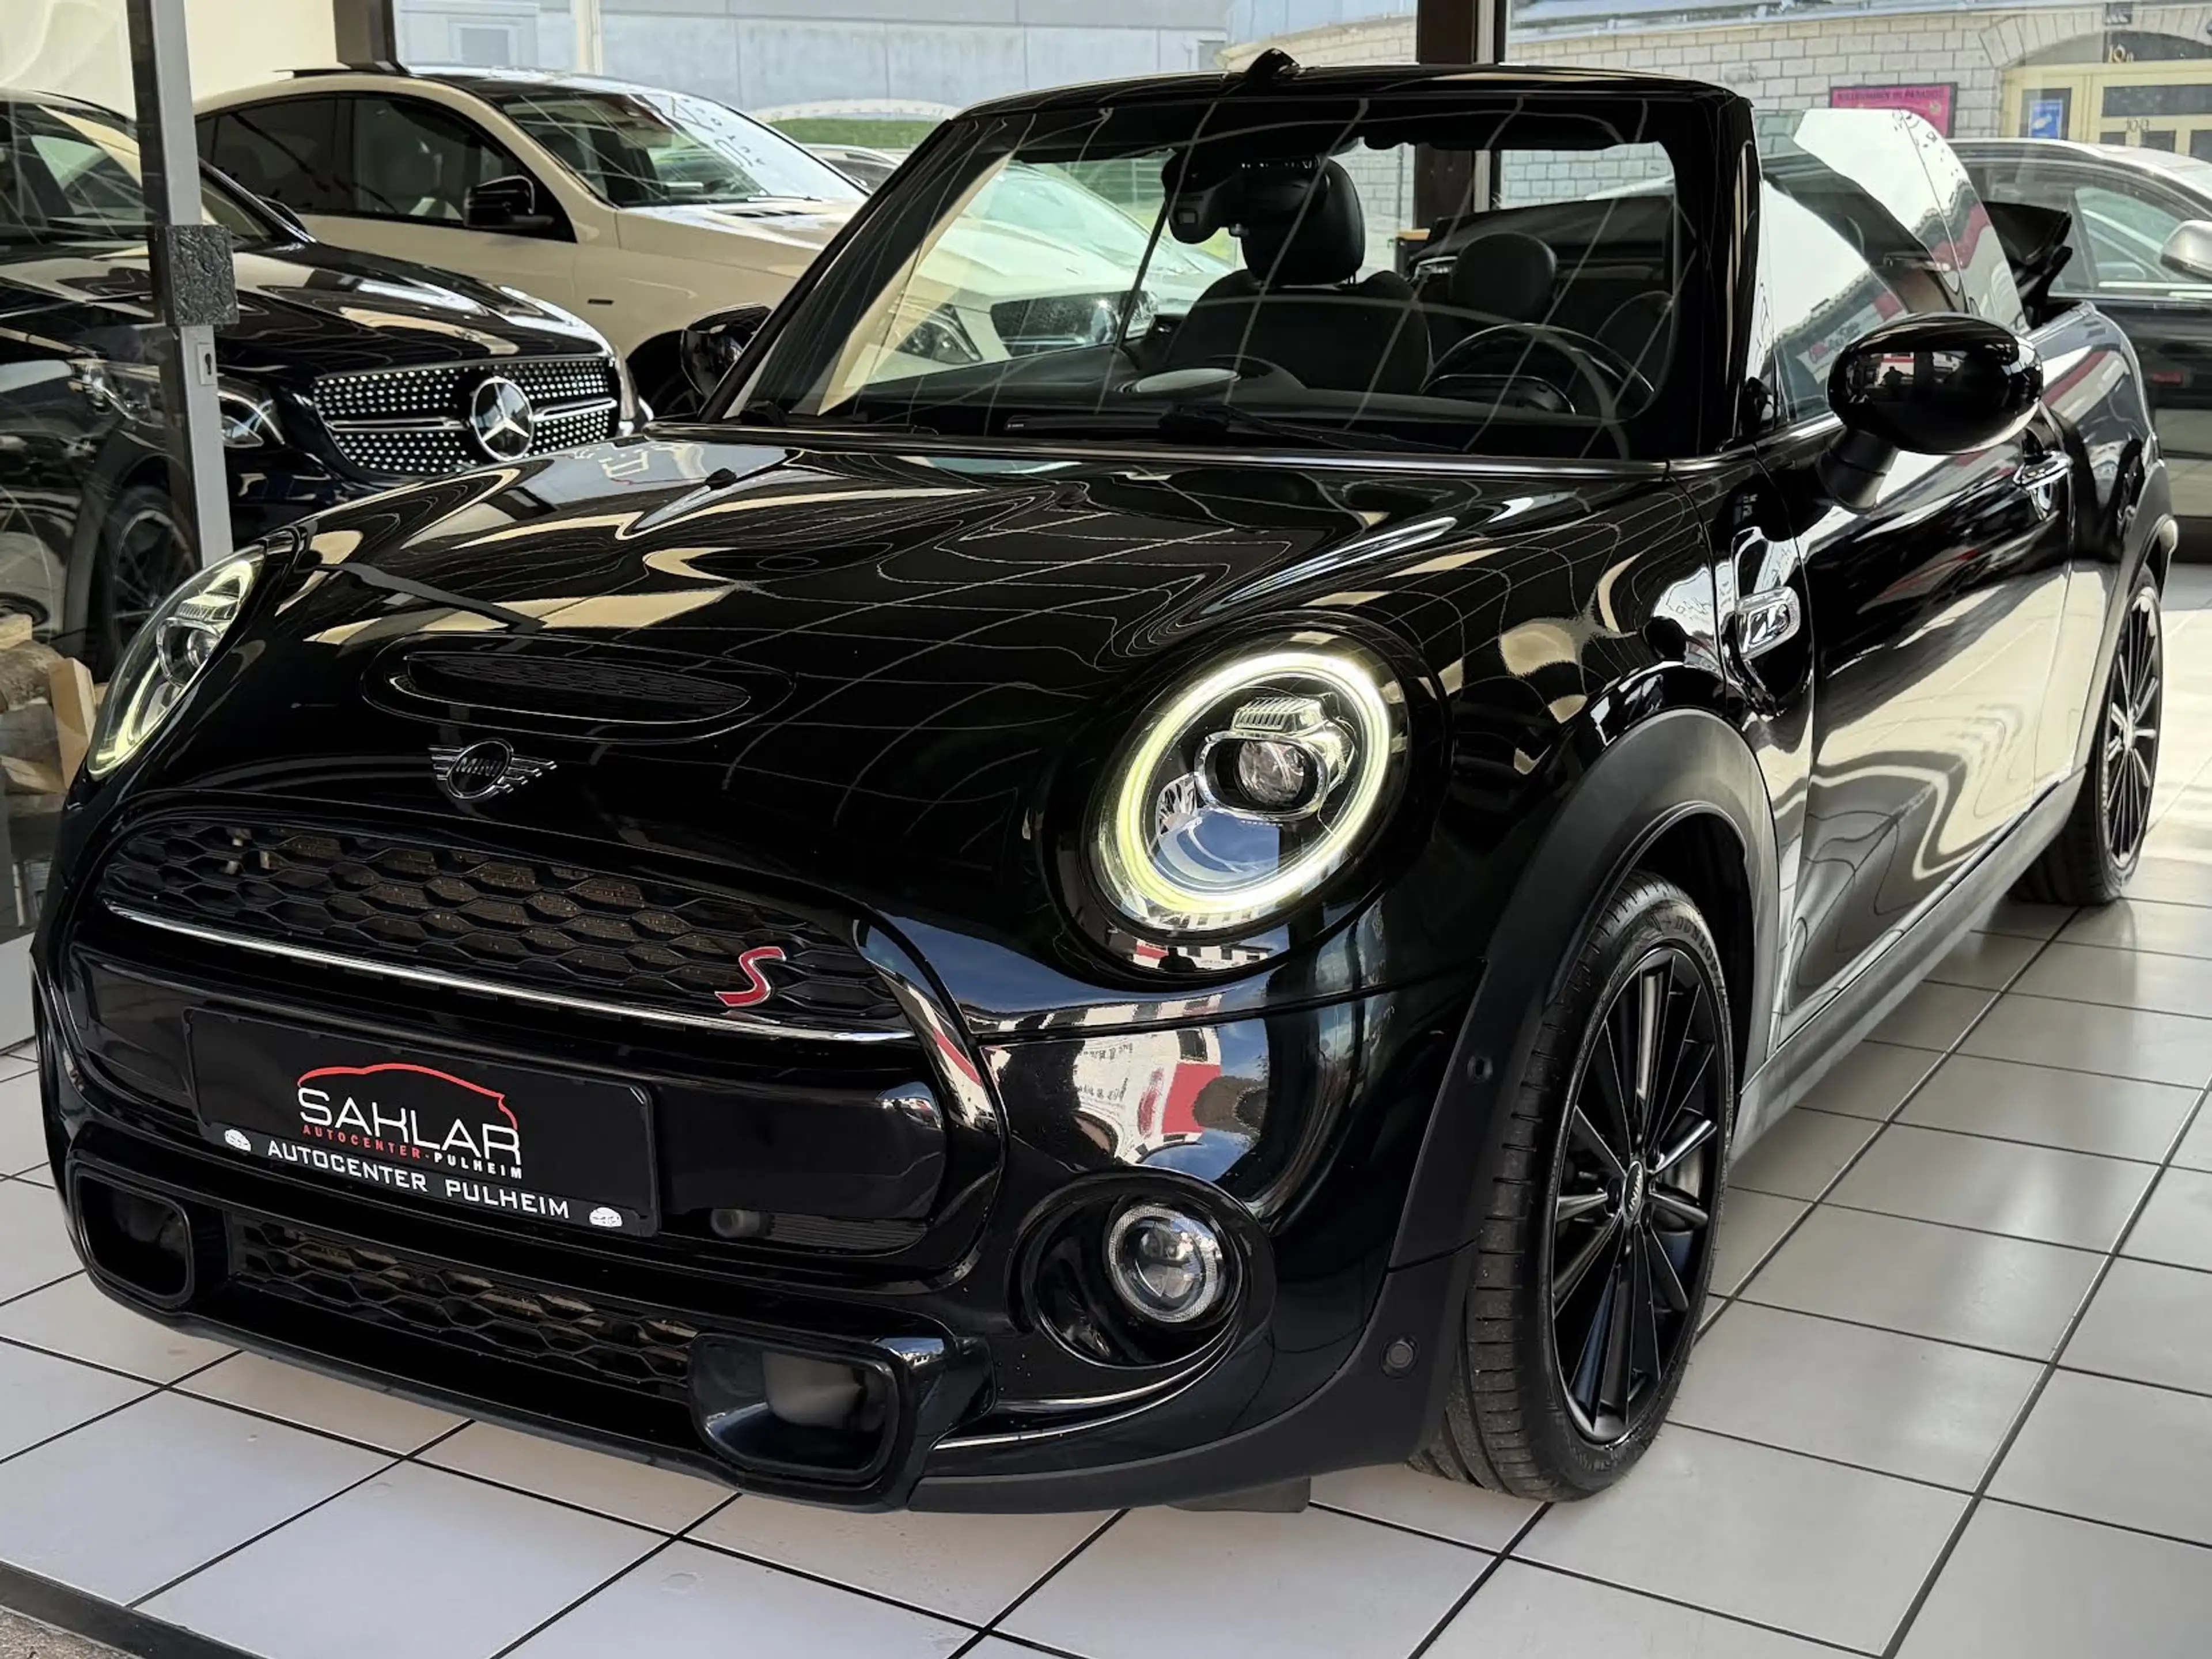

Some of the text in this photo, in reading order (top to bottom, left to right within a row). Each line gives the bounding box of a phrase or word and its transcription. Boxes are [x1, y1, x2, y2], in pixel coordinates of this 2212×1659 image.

[456, 756, 503, 777] MINI
[1674, 915, 1719, 972] DUNLOP
[714, 946, 787, 1007] S
[268, 1140, 569, 1219] AUTOCENTER PULHEIM
[1628, 1169, 1643, 1211] MINI
